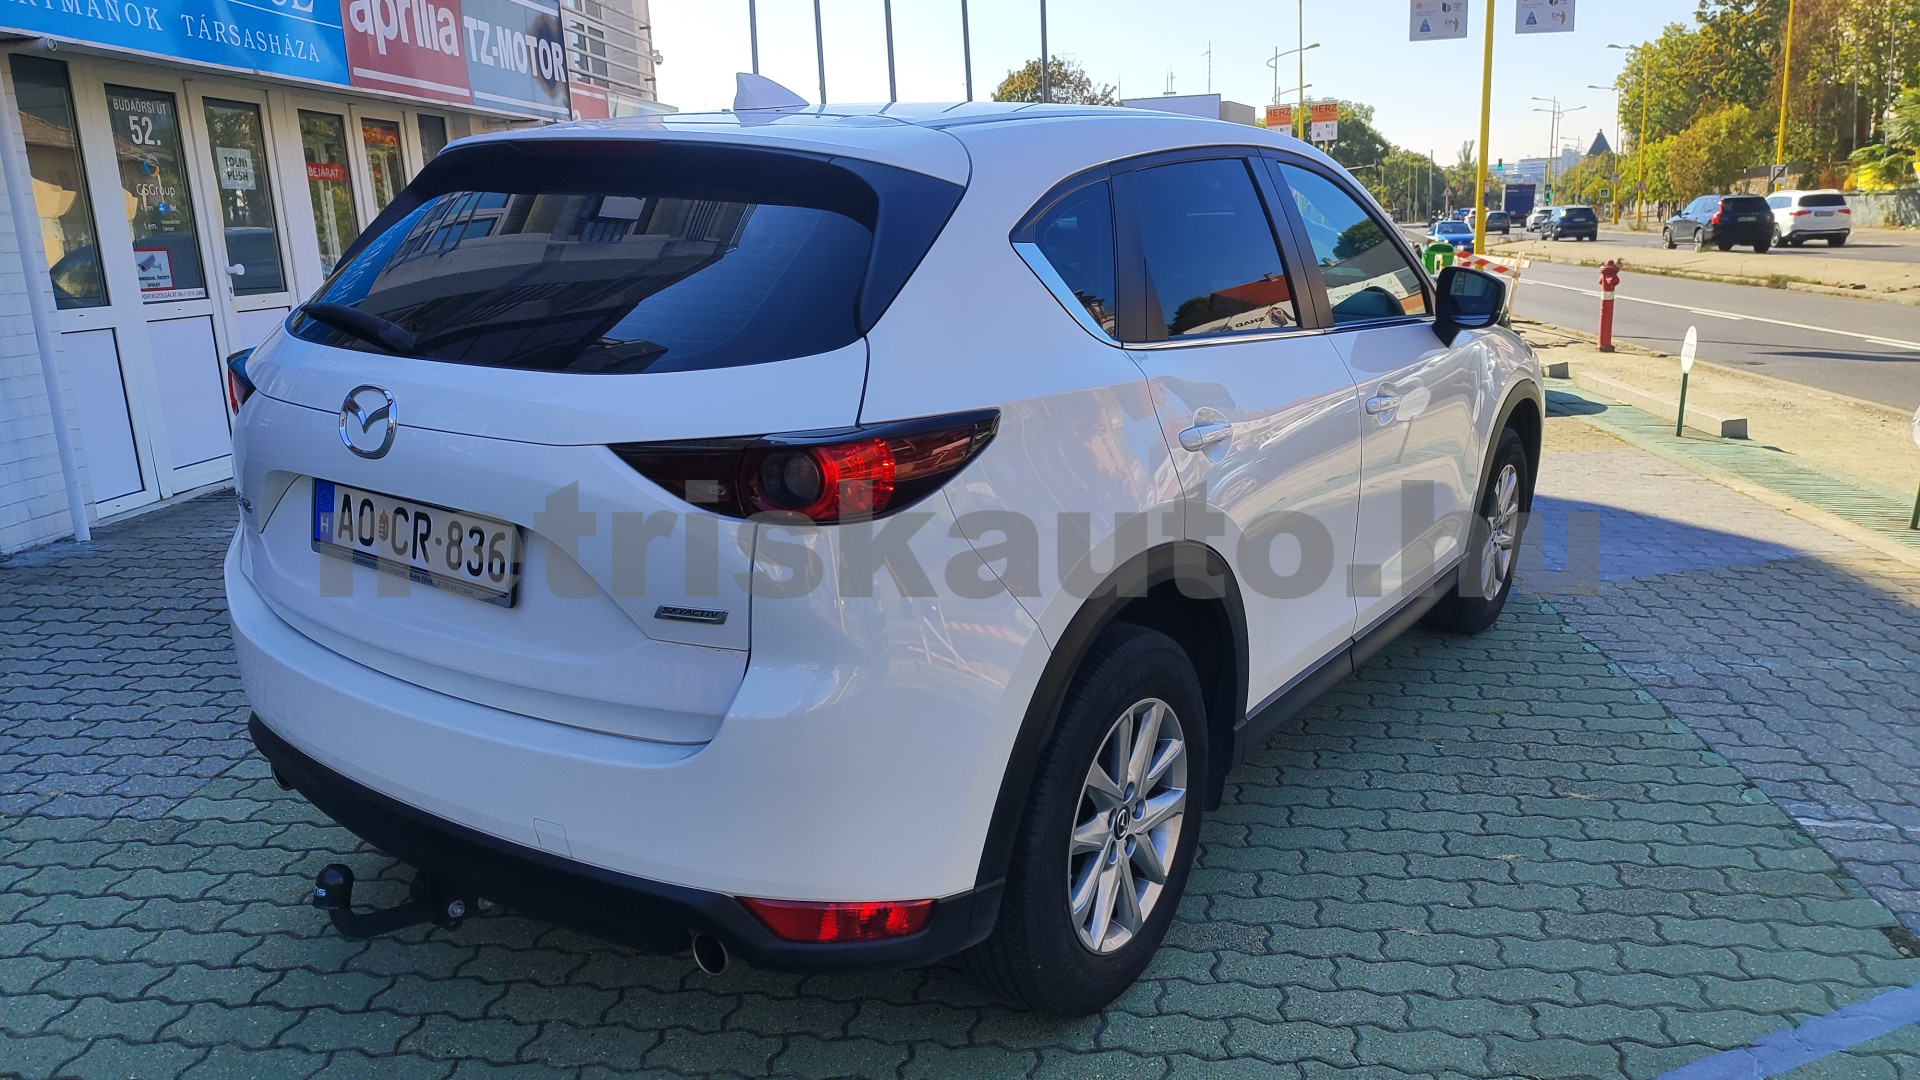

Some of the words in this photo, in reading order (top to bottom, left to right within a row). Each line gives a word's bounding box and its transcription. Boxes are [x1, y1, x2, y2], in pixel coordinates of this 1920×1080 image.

[9, 0, 163, 31] MANOK
[180, 13, 320, 63] TÁRSASHÁZA
[349, 0, 460, 57] aprilia
[463, 15, 567, 83] TZ-MOTOR
[1267, 107, 1291, 117] HERZ
[1312, 104, 1337, 113] HERZ
[128, 115, 162, 146] 52.
[227, 170, 249, 182] PUSH
[308, 165, 339, 178] BEJÁRAT
[662, 606, 720, 617] SKYACTIV
